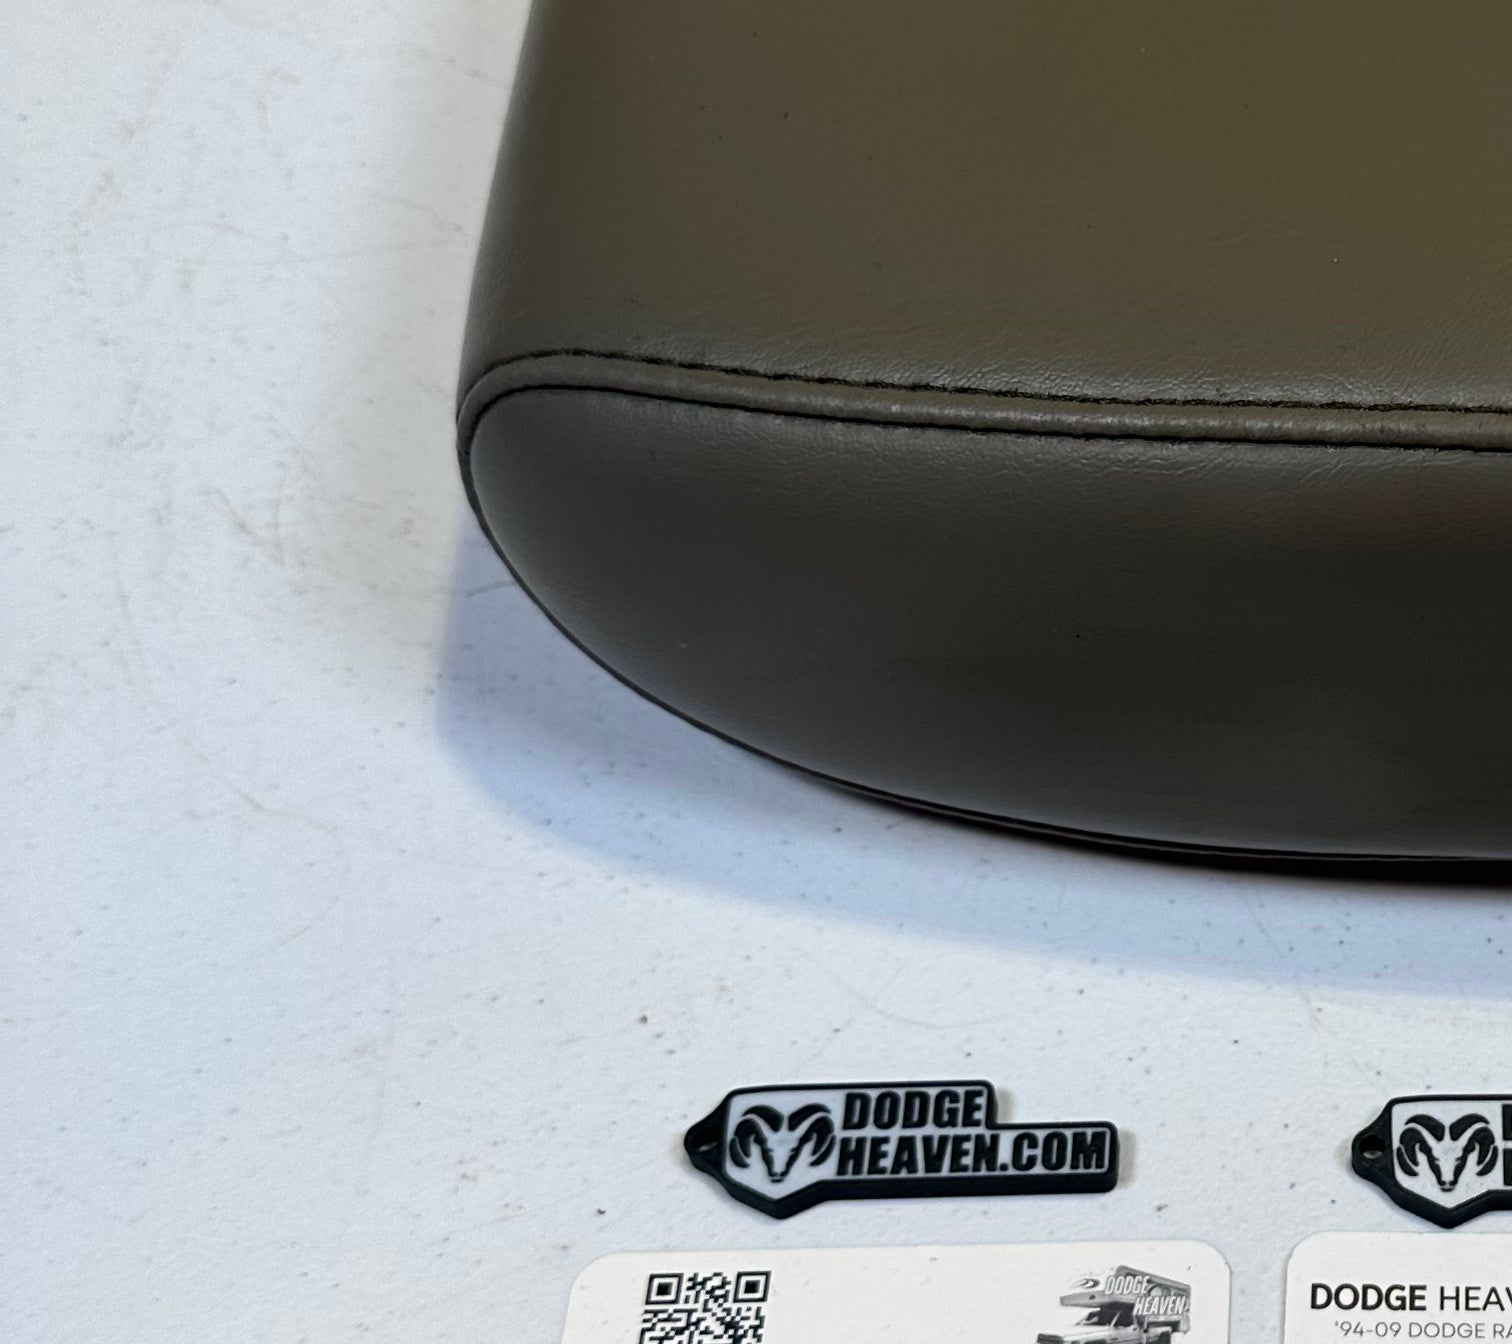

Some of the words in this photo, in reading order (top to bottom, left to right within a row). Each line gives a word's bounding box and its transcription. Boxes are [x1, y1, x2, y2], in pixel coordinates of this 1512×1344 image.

[842, 1088, 986, 1130] DODGE
[836, 1130, 1105, 1176] HEAVEN.COM
[1105, 1275, 1150, 1295] DODGE
[1311, 1283, 1427, 1311] DODGE
[1133, 1296, 1187, 1315] HEAVEN
[1408, 1322, 1485, 1339] DODGE
